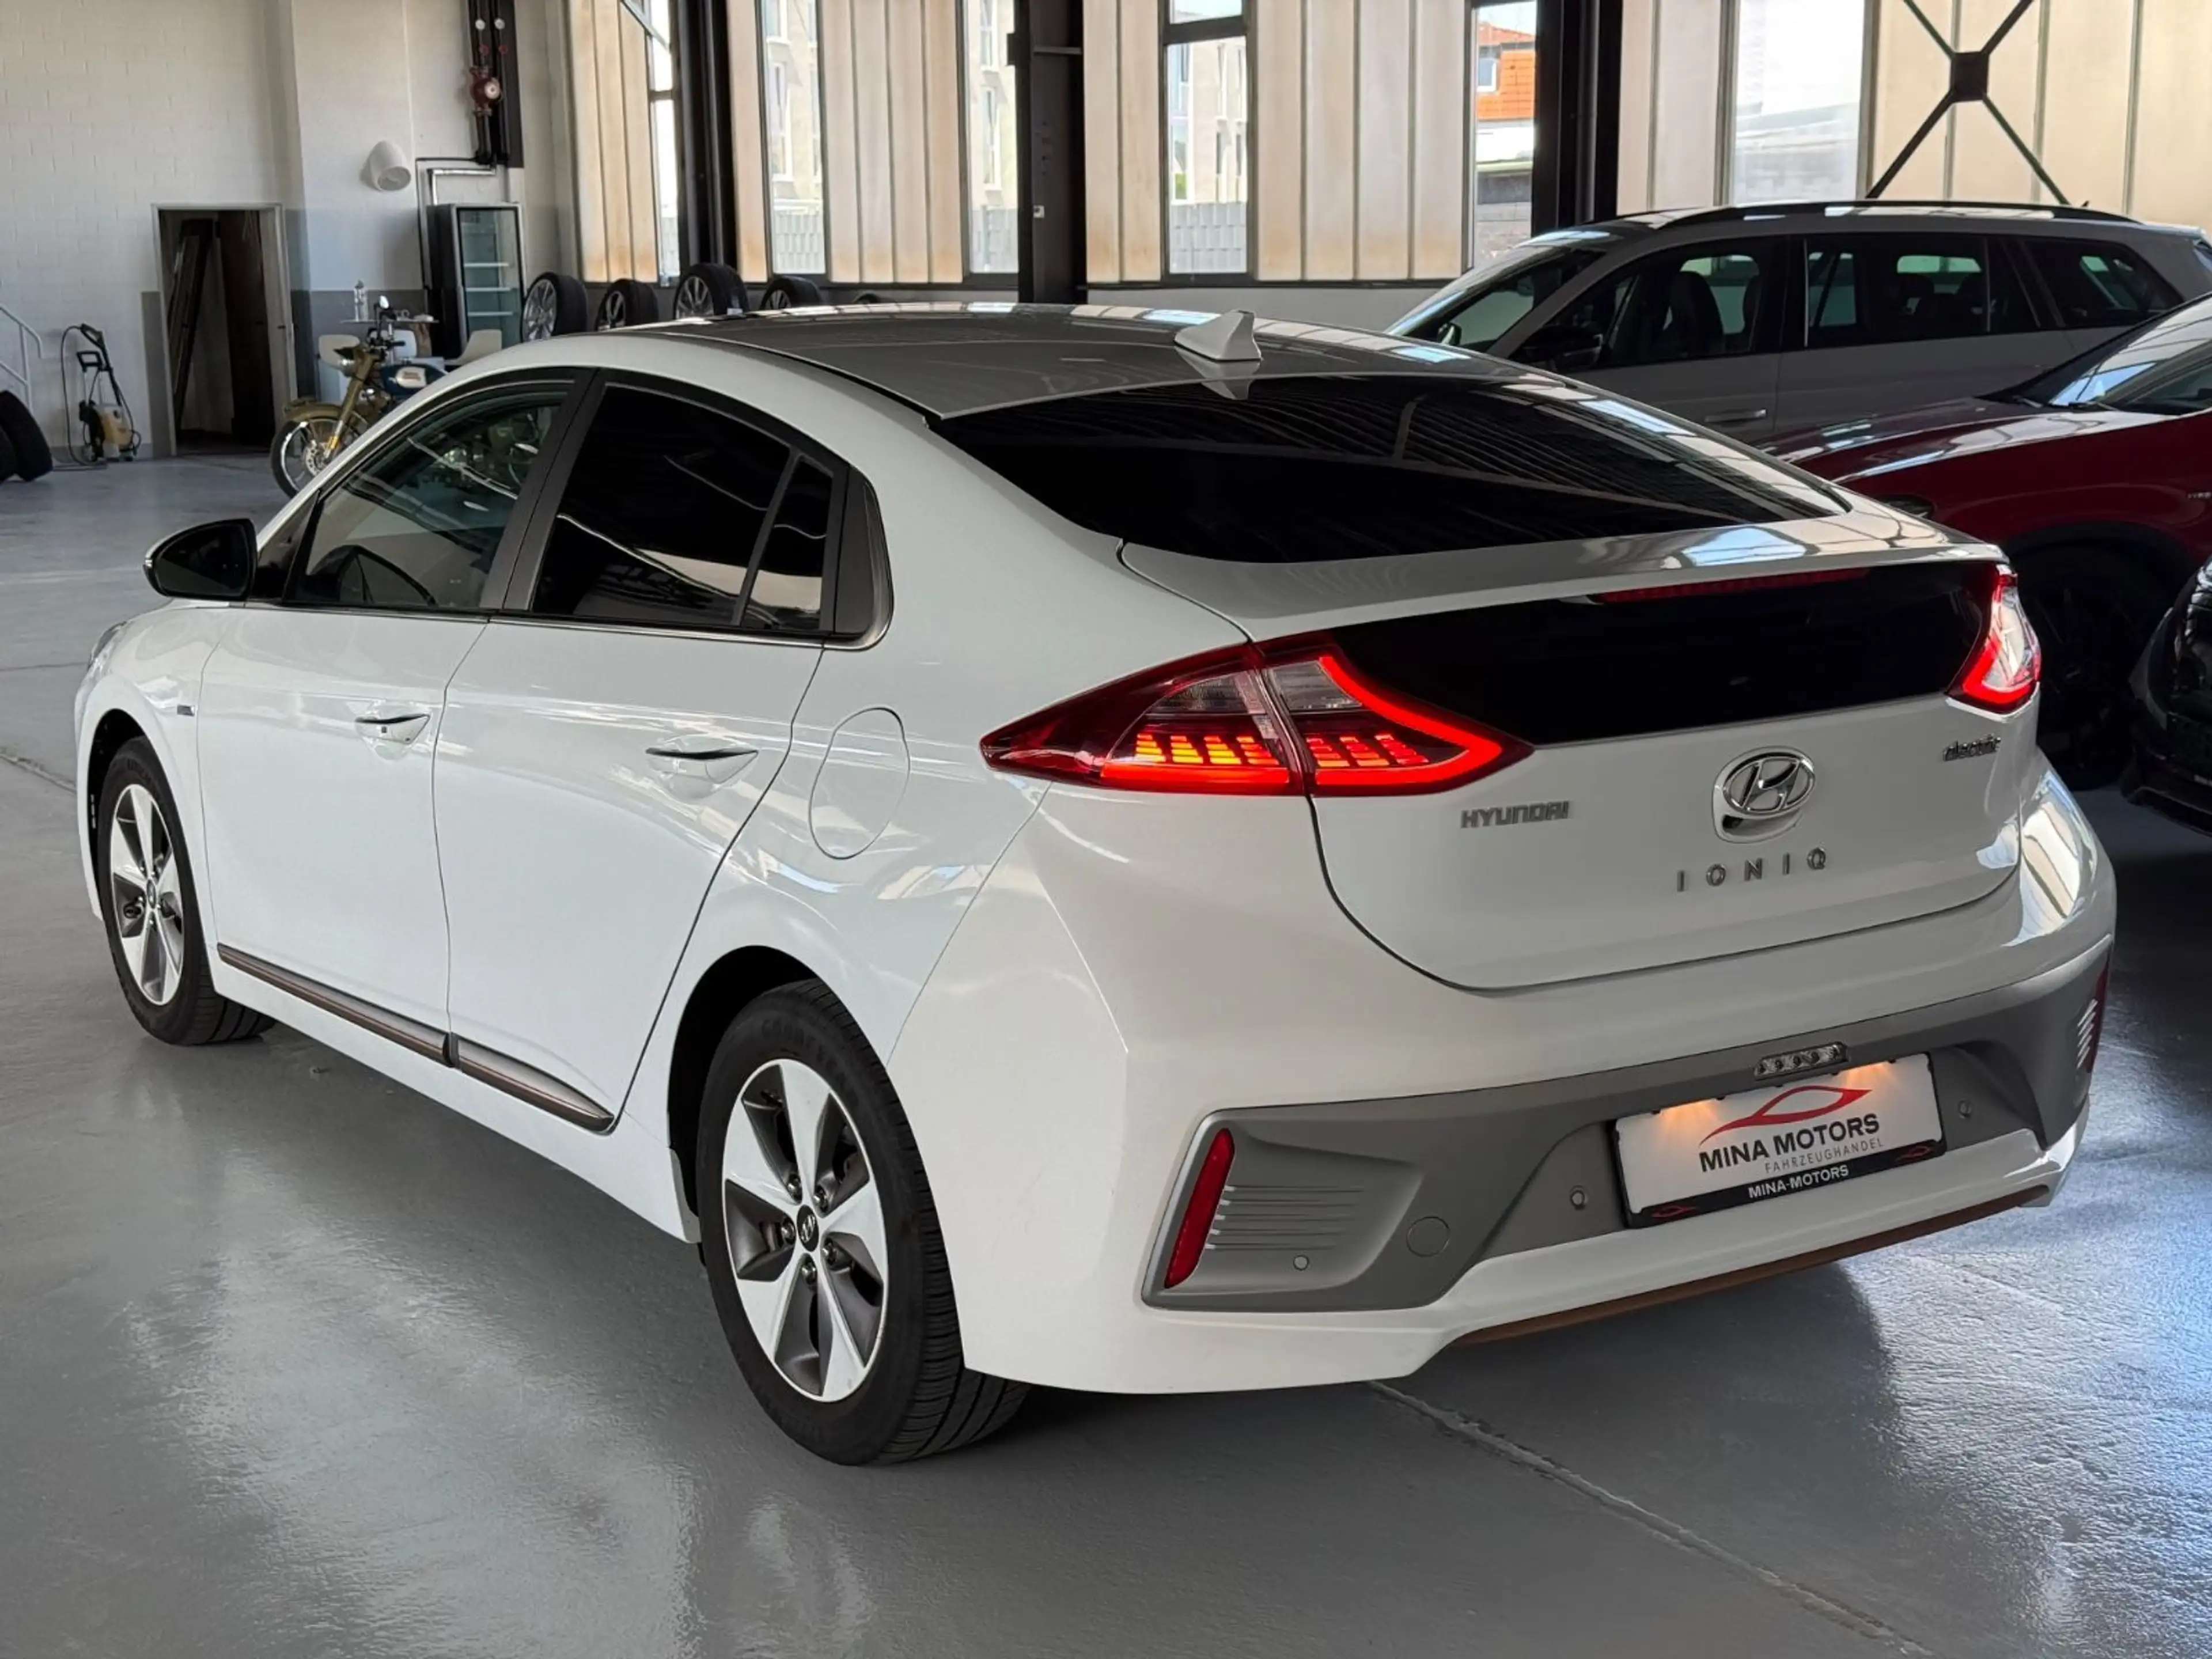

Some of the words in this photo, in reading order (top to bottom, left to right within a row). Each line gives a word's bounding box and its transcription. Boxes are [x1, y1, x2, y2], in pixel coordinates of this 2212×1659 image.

[1461, 800, 1569, 828] HYUNDAI
[1677, 847, 1827, 892] IONIQ
[1699, 1139, 1769, 1173] MINA
[1773, 1113, 1880, 1156] MOTORS
[1764, 1137, 1885, 1173] FAHRZEUGHANDEL
[1748, 1164, 1849, 1199] MINA-MOTORS
